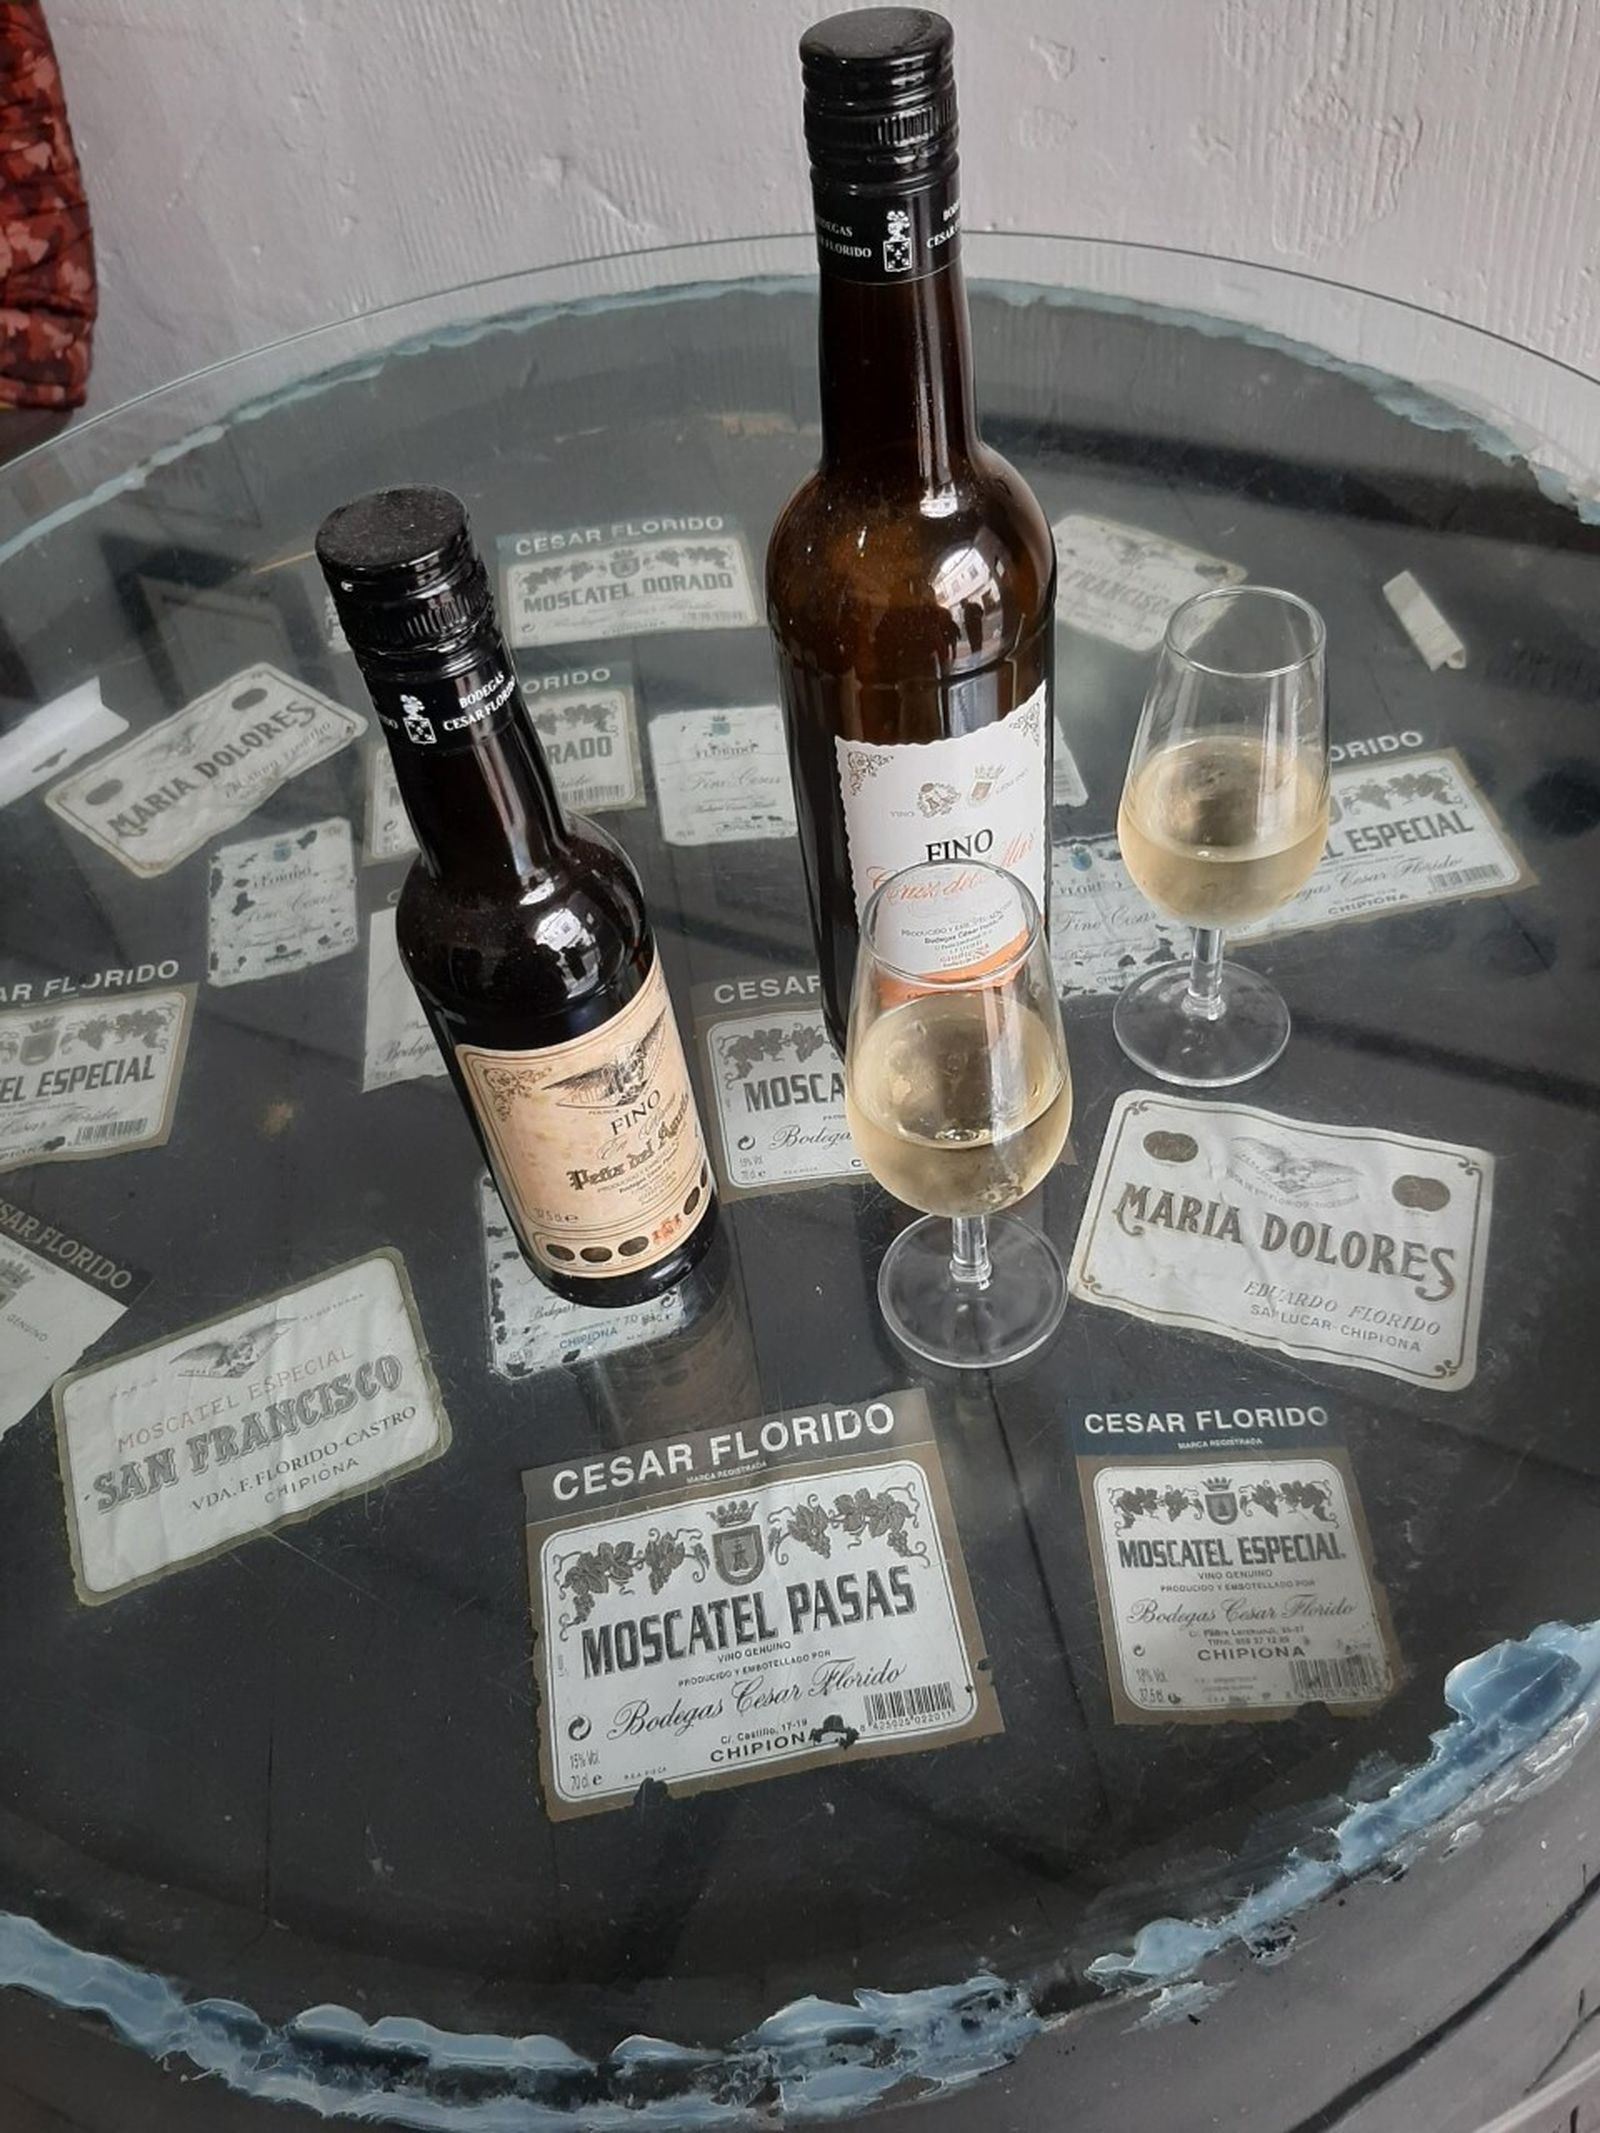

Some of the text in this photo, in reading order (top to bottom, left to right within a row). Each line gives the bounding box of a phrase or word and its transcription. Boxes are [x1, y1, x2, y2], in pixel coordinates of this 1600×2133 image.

[515, 516, 724, 556] CESAR FLORIDO
[523, 572, 734, 614] MOSCATEL DORADO
[458, 671, 504, 709] BODEGAS
[522, 668, 611, 694] ORIDO
[443, 708, 485, 731] CESAR
[549, 735, 613, 766] RADO
[1329, 730, 1425, 763] ORIDO
[107, 778, 198, 838] MARIA
[193, 701, 317, 780] DOLORES
[926, 828, 993, 863] FINO
[1345, 810, 1475, 854] ESPECIAL
[43, 959, 180, 998] FLORIDO
[36, 1054, 156, 1098] ESPECIAL
[743, 1072, 845, 1113] MOSCA
[611, 1089, 661, 1136] FINO
[769, 1124, 852, 1151] Bodega
[0, 1202, 133, 1290] SAR FLORIDO
[1112, 1181, 1243, 1245] MARIA
[1261, 1212, 1457, 1302] DOLORES
[559, 1326, 618, 1350] CHIPIONA
[1347, 1304, 1441, 1337] FLORIDO
[117, 1345, 354, 1454] MOSCATEL ESPECIAL
[92, 1353, 404, 1515] SAN FRANCISCO
[1084, 1406, 1329, 1434] CESAR FLORIDO
[552, 1401, 896, 1501] CESAR FLORIDO
[263, 1456, 360, 1505] CHIPIONA
[1116, 1531, 1347, 1569] MOSCATEL ESPECIAL
[1197, 1568, 1273, 1580] VINO GENUINO
[581, 1565, 918, 1681] MOSCATEL PASAS
[1126, 1593, 1358, 1630] Bodegas Cesar Florido
[677, 1669, 733, 1688] PRODUCIDO
[742, 1654, 810, 1676] EMBOTELLADO
[717, 1640, 792, 1664] VINO GENUINO
[1197, 1645, 1306, 1662] CHIPIONA
[606, 1656, 906, 1742] Bodegas Cesar Florido
